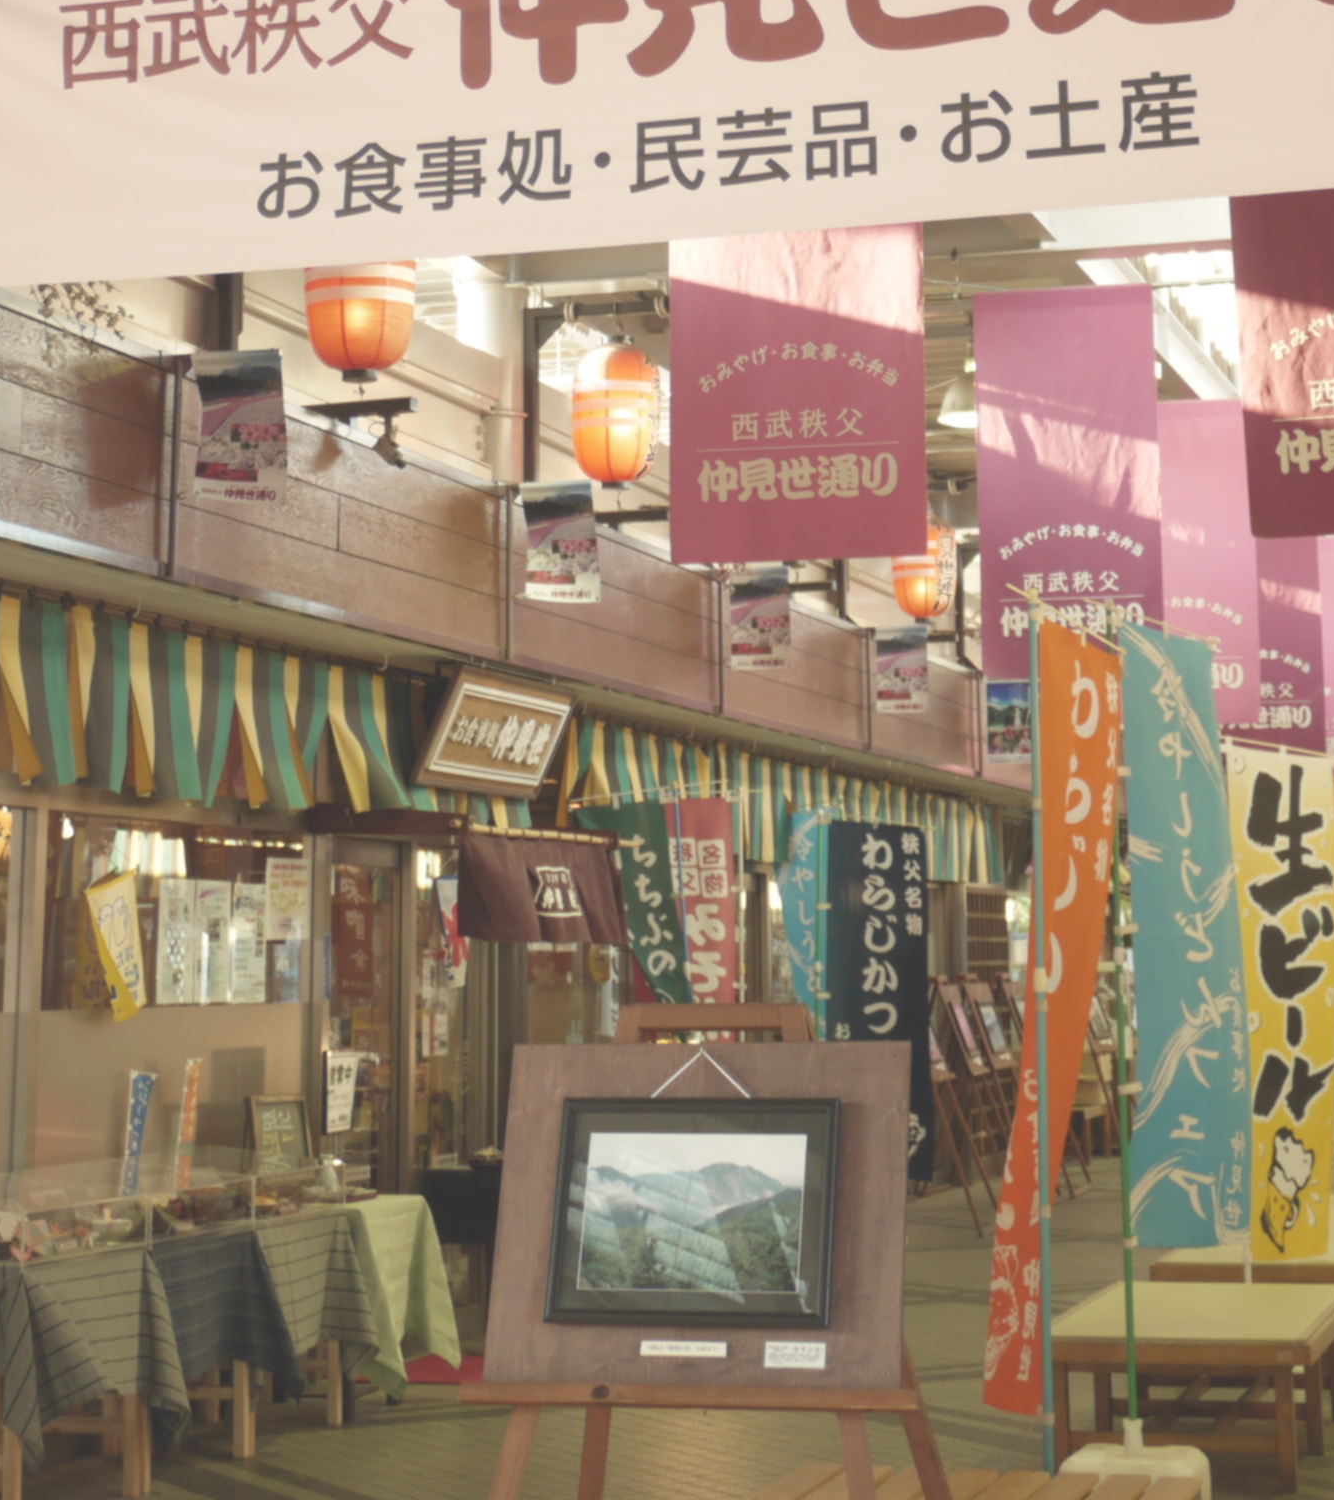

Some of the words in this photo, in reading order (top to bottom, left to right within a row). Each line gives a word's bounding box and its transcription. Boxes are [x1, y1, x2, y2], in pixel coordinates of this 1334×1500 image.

[255, 72, 1201, 224] お食事処・民芸品・お土産
[698, 341, 901, 394] おみやげ・お食事・お弁当
[731, 407, 864, 442] 西武秩父
[697, 451, 899, 503] 仲見世通り
[998, 522, 1145, 561] おみやげ・お食事・お弁当
[1022, 569, 1120, 595] 西武秩父
[490, 713, 552, 766] 仲見世
[900, 832, 923, 936] 秩父名物
[861, 832, 899, 1035] わらじかつ
